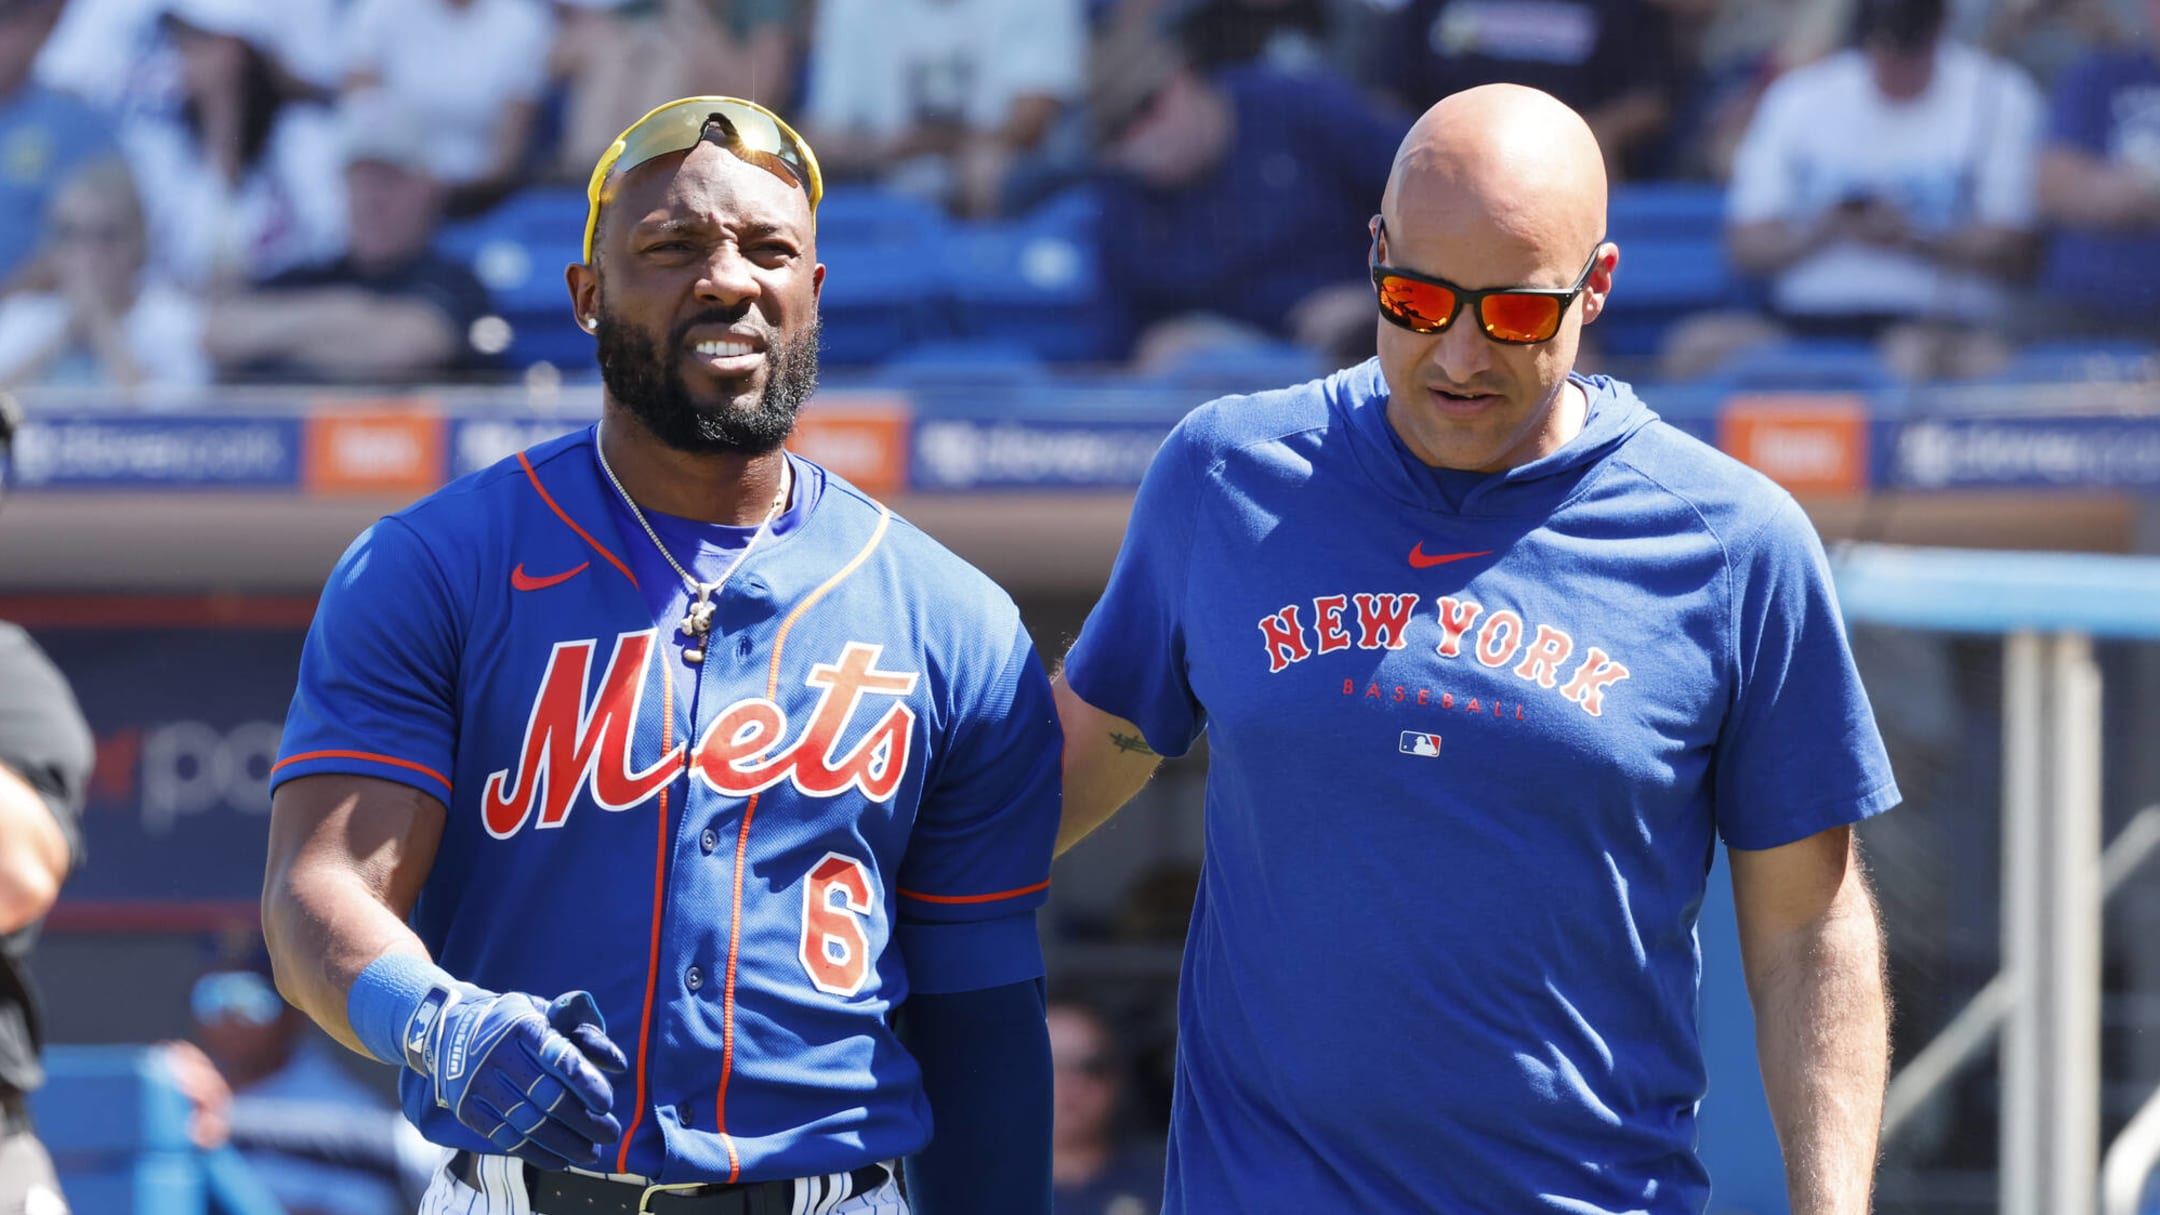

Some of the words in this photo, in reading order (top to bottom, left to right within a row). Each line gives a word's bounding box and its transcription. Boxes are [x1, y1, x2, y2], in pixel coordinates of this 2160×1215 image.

[1258, 593, 1419, 673] NEW
[1436, 596, 1630, 717] YORK
[1343, 679, 1526, 721] BASEBALL
[481, 627, 919, 839] Mets
[799, 851, 874, 997] 6
